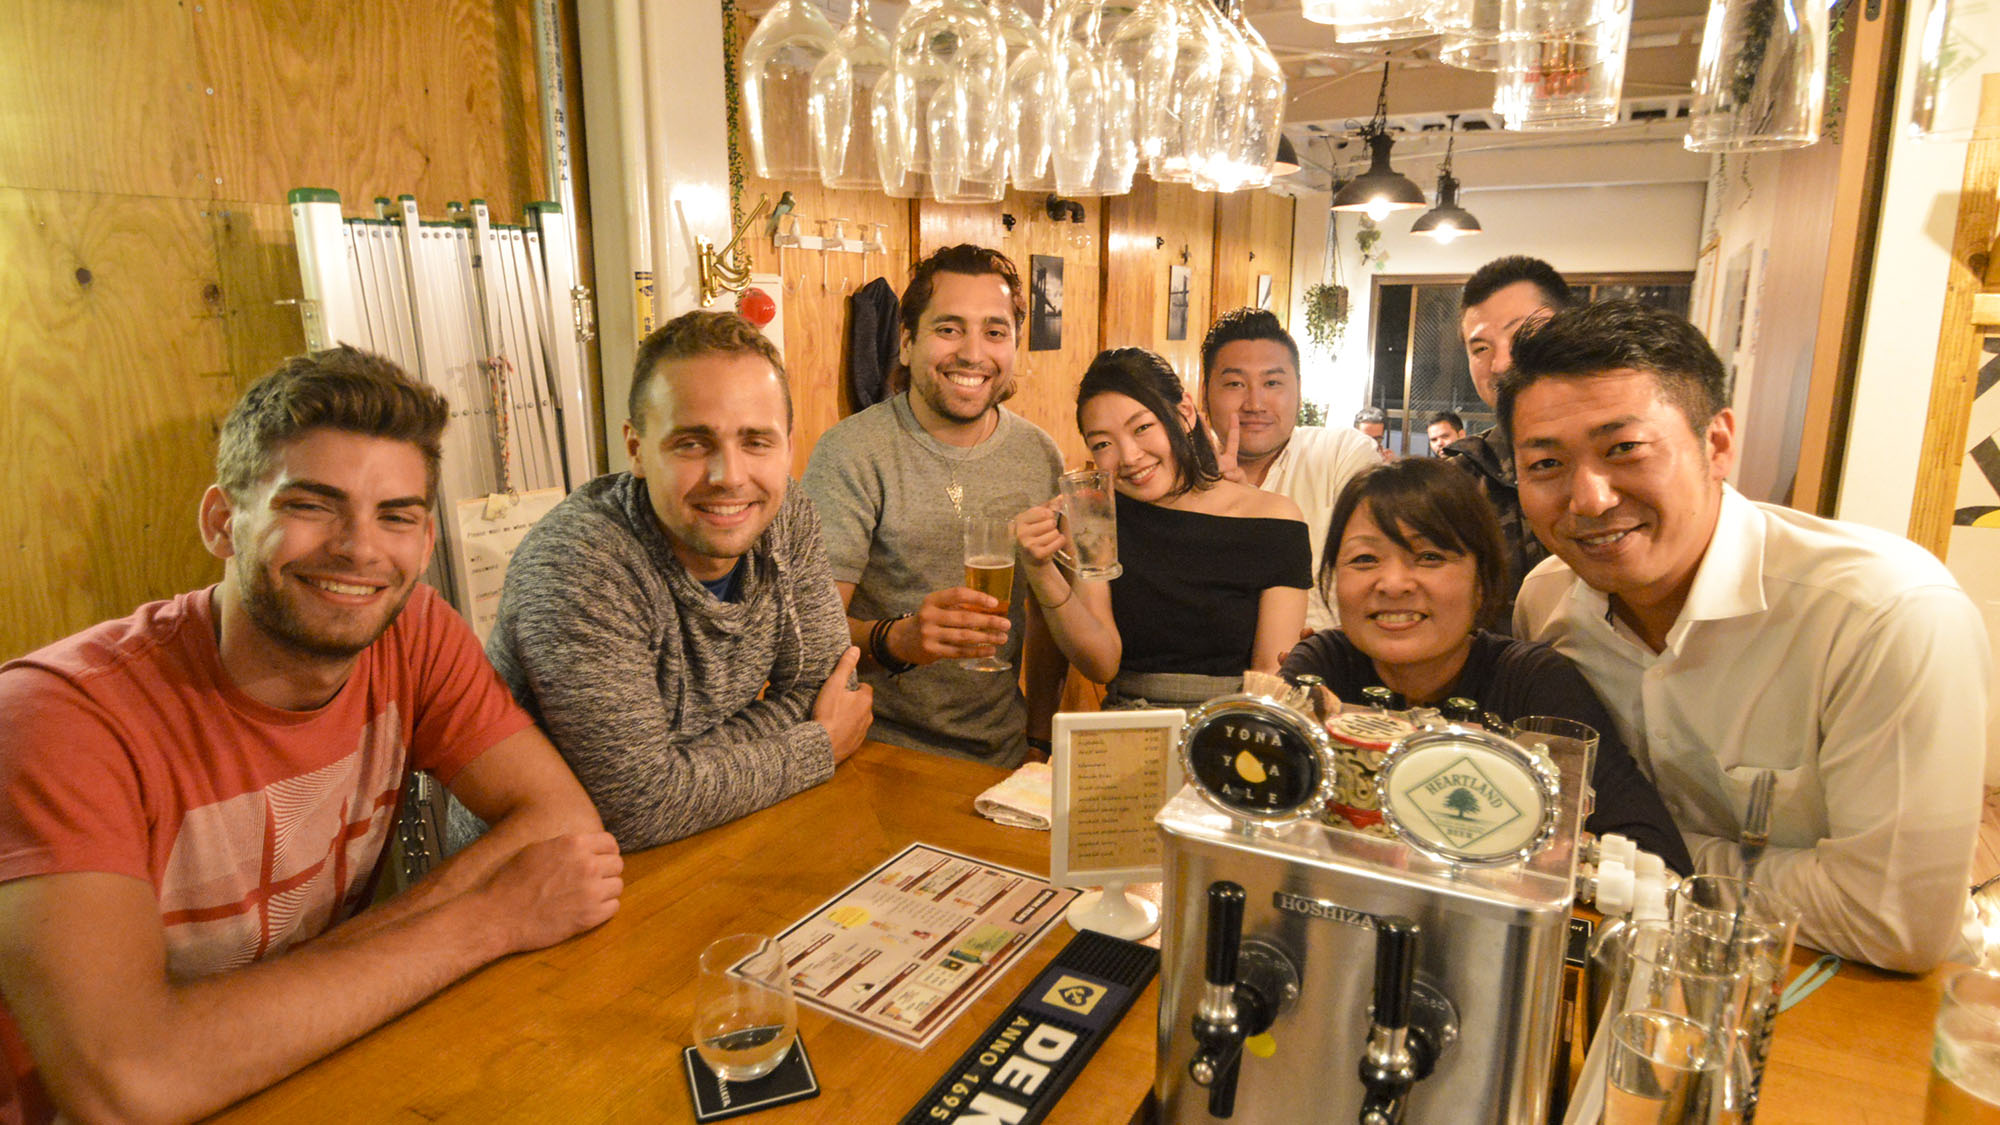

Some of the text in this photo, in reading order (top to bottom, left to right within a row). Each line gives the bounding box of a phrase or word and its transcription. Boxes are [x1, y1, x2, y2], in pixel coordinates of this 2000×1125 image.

[1225, 725, 1282, 747] YONA
[1222, 783, 1278, 804] ALE
[1425, 773, 1503, 808] HEARTLAND
[930, 1015, 1030, 1121] ANNO 1695
